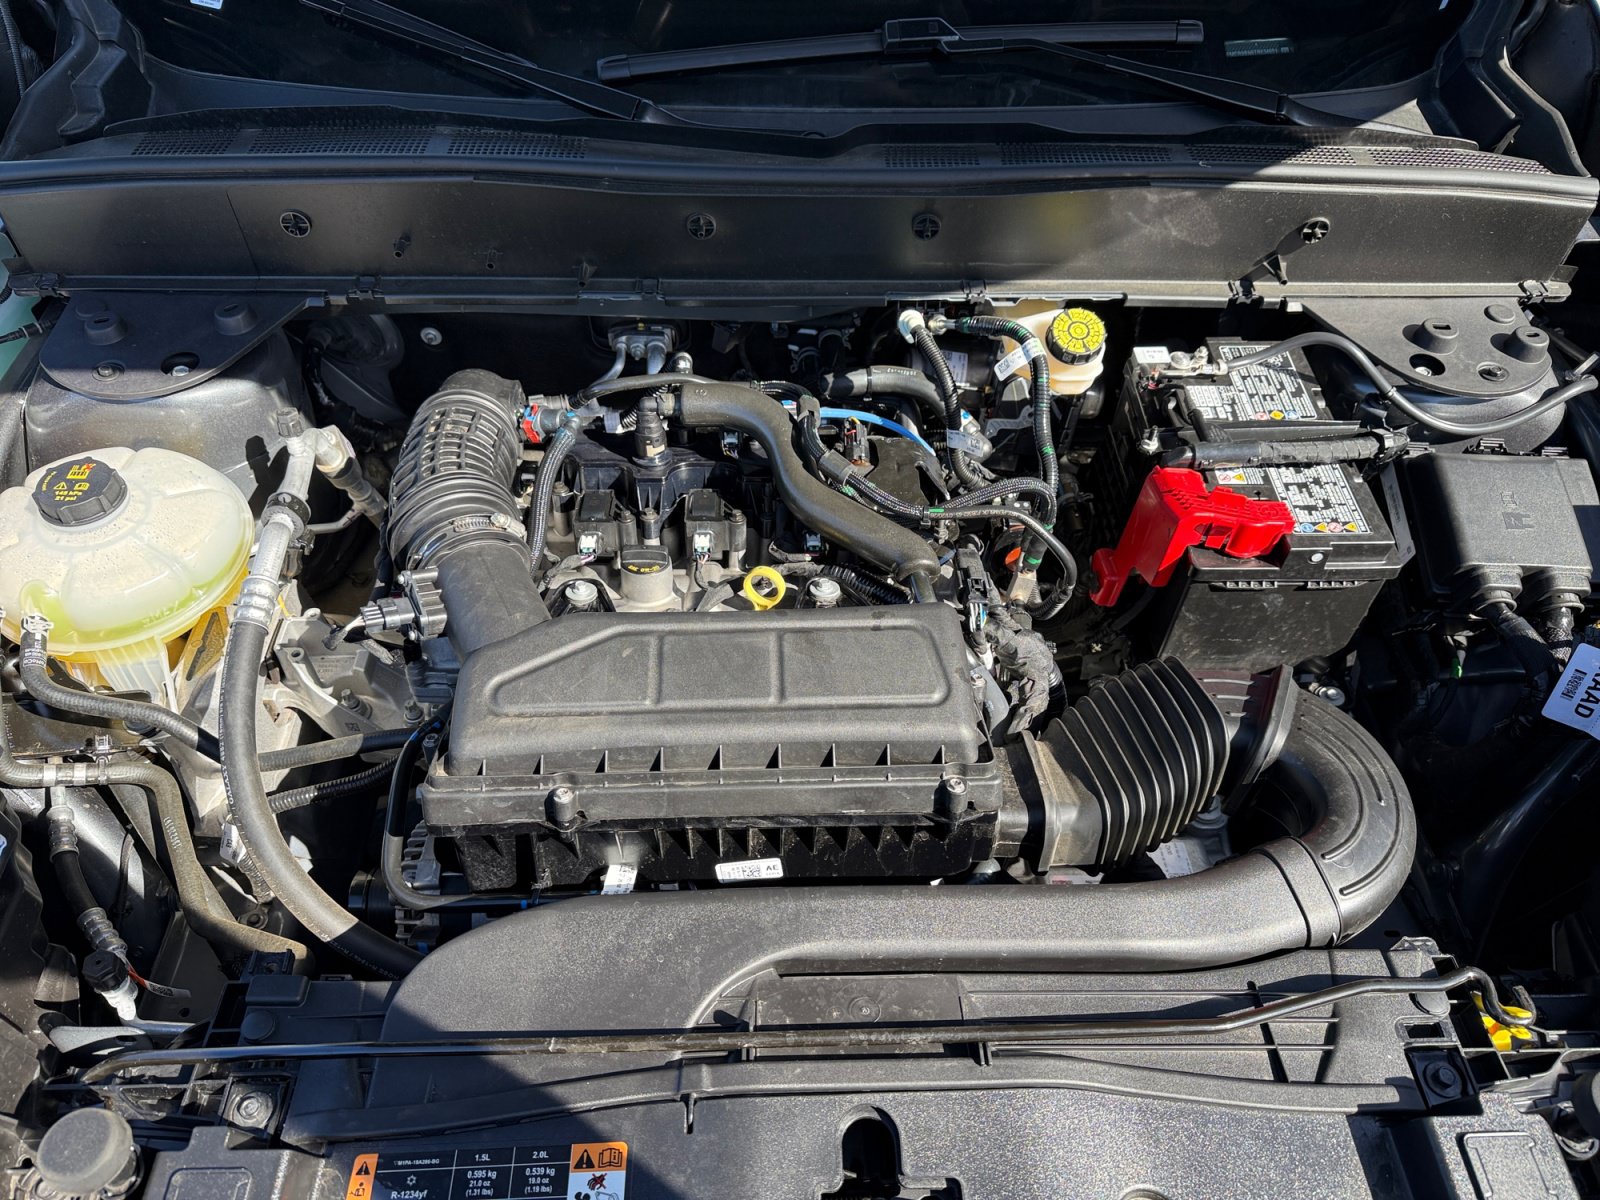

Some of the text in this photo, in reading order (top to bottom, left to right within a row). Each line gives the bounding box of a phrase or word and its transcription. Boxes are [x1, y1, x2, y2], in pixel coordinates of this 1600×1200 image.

[1574, 665, 1600, 719] AAD
[475, 1154, 491, 1162] 1.5L
[532, 1151, 549, 1159] 2.0L
[467, 1170, 497, 1180] 0.595 kg
[525, 1166, 556, 1176] 0.539 kg
[391, 1189, 428, 1200] R-1234yf
